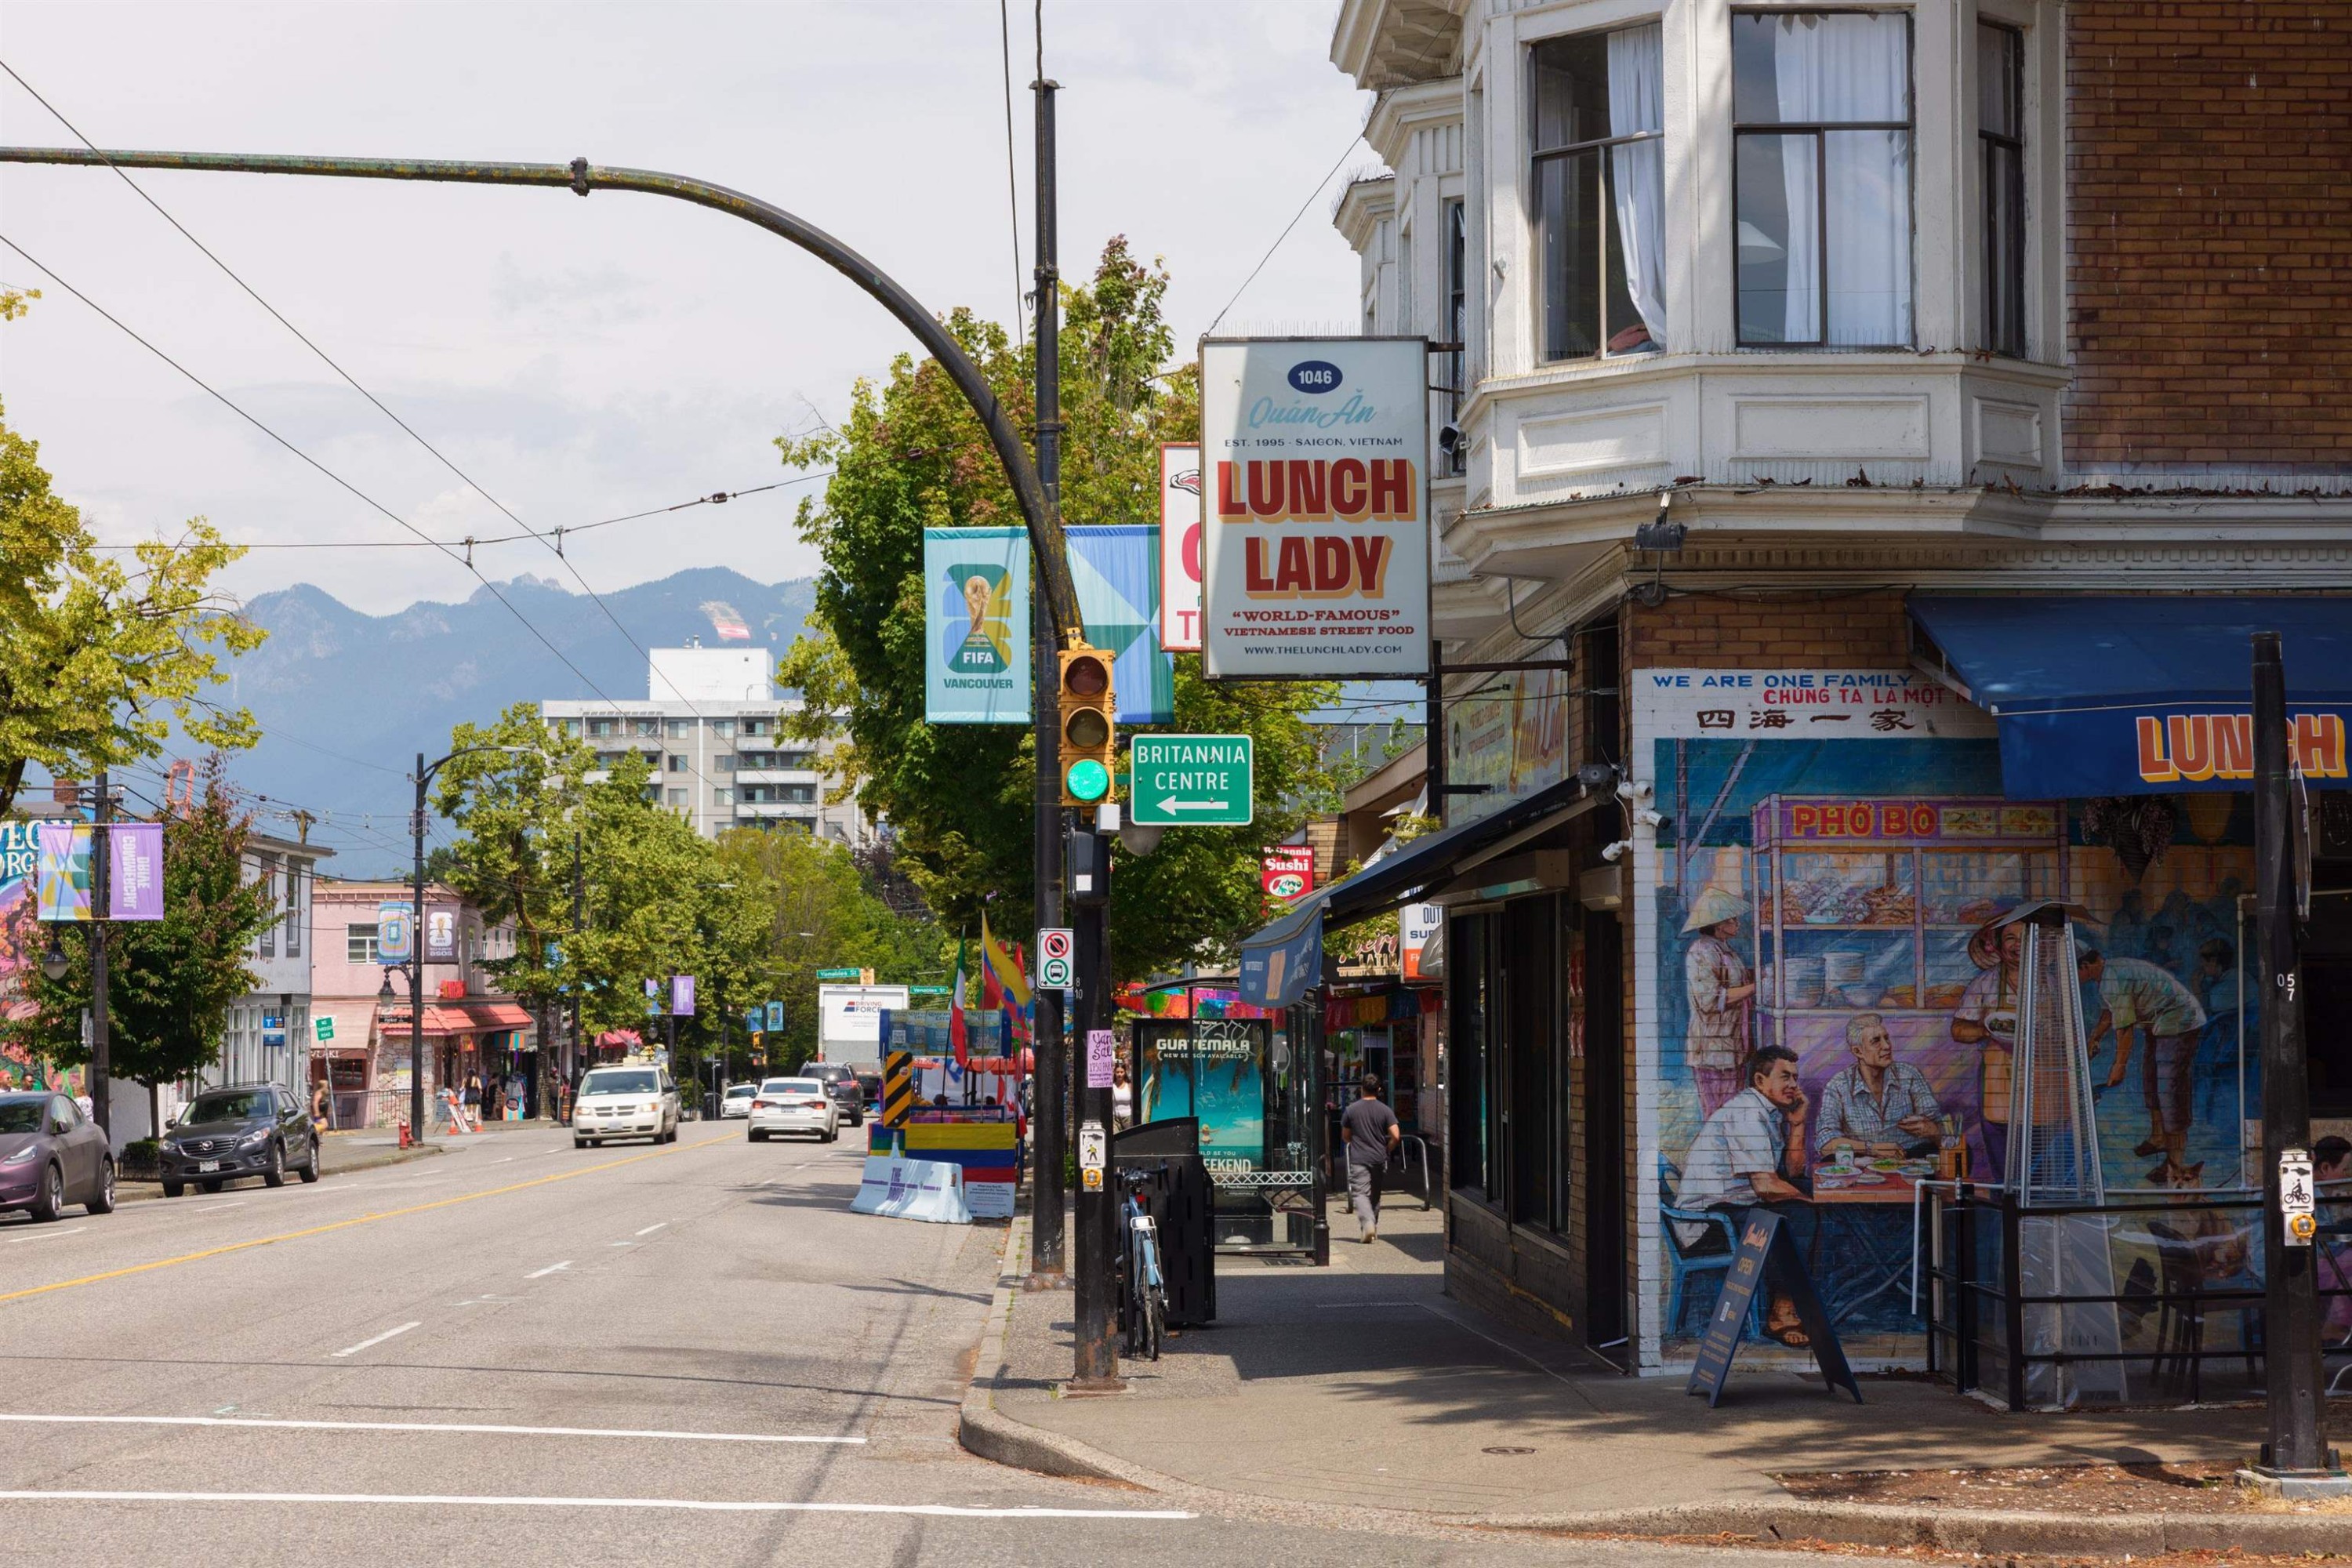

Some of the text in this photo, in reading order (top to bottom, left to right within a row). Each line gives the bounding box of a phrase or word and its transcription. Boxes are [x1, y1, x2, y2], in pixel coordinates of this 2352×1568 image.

[1298, 370, 1333, 384] 1046
[1249, 397, 1319, 430] Quán
[1256, 438, 1285, 447] 1995
[1296, 438, 1346, 448] SAIGON,
[1349, 437, 1403, 446] VIETNAM
[1217, 458, 1417, 523] LUNCH
[1245, 535, 1394, 600] LADY
[1225, 626, 1414, 637] VIETNAMESE STREET FOOD
[963, 652, 994, 664] FIFA
[944, 678, 1014, 689] VANCOUVER
[1652, 674, 1913, 688] WE ARE ONE FAMILY
[1840, 688, 1863, 704] TA
[1697, 708, 1915, 731] 四海一家
[2136, 713, 2348, 782] LUNH
[1138, 746, 1246, 764] BRITANNIA
[1155, 772, 1229, 790] CENTRE
[1265, 858, 1309, 872] Sushi
[1076, 977, 1081, 987] 8
[1075, 989, 1083, 1000] 10
